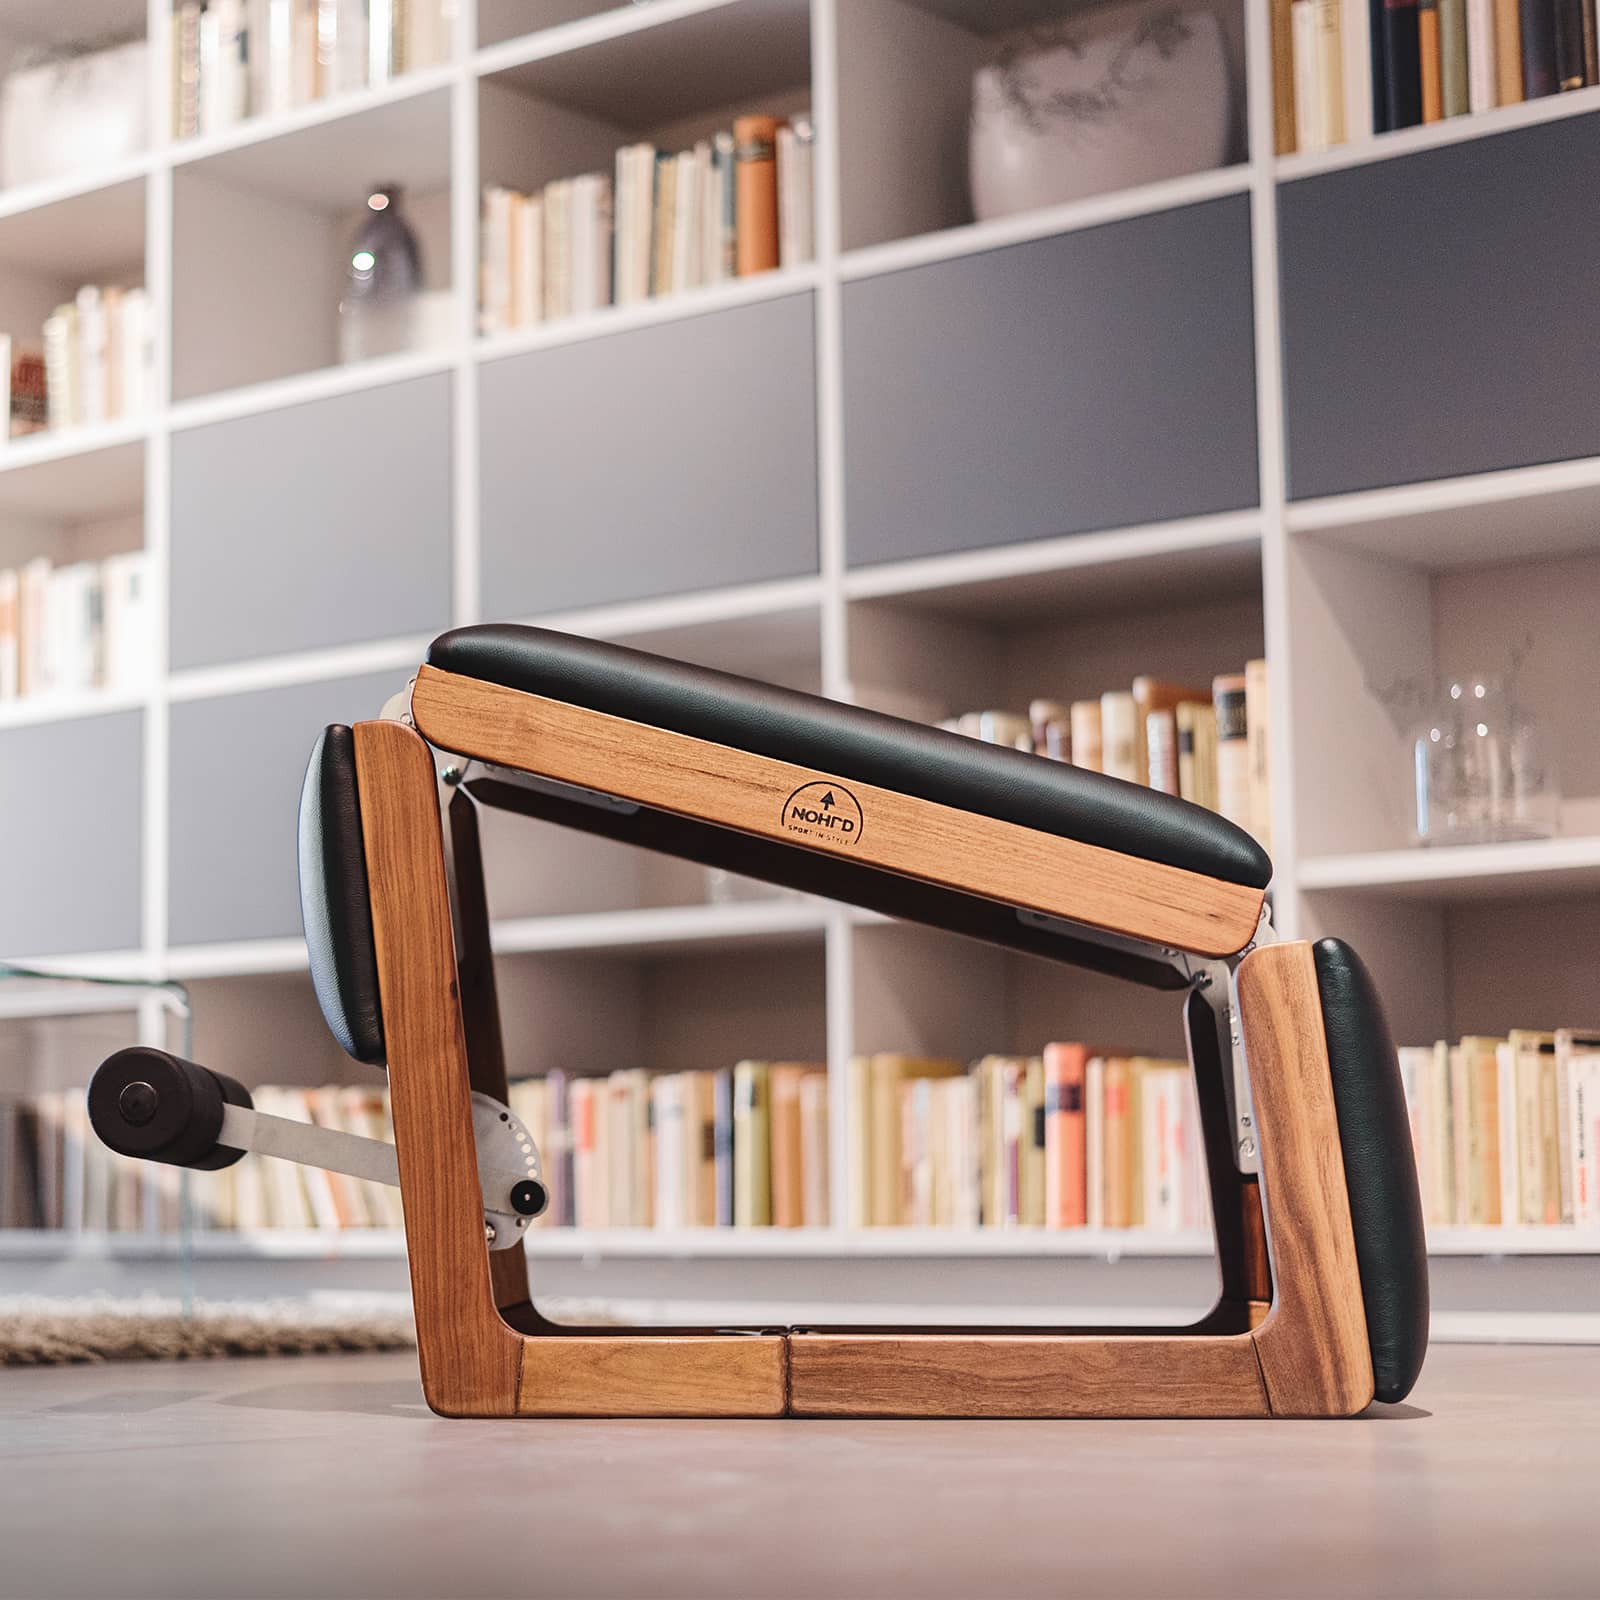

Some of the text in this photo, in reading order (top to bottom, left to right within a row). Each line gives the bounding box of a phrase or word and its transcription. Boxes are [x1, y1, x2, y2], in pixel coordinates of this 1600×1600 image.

[788, 824, 849, 846] SPORT IN STYLE
